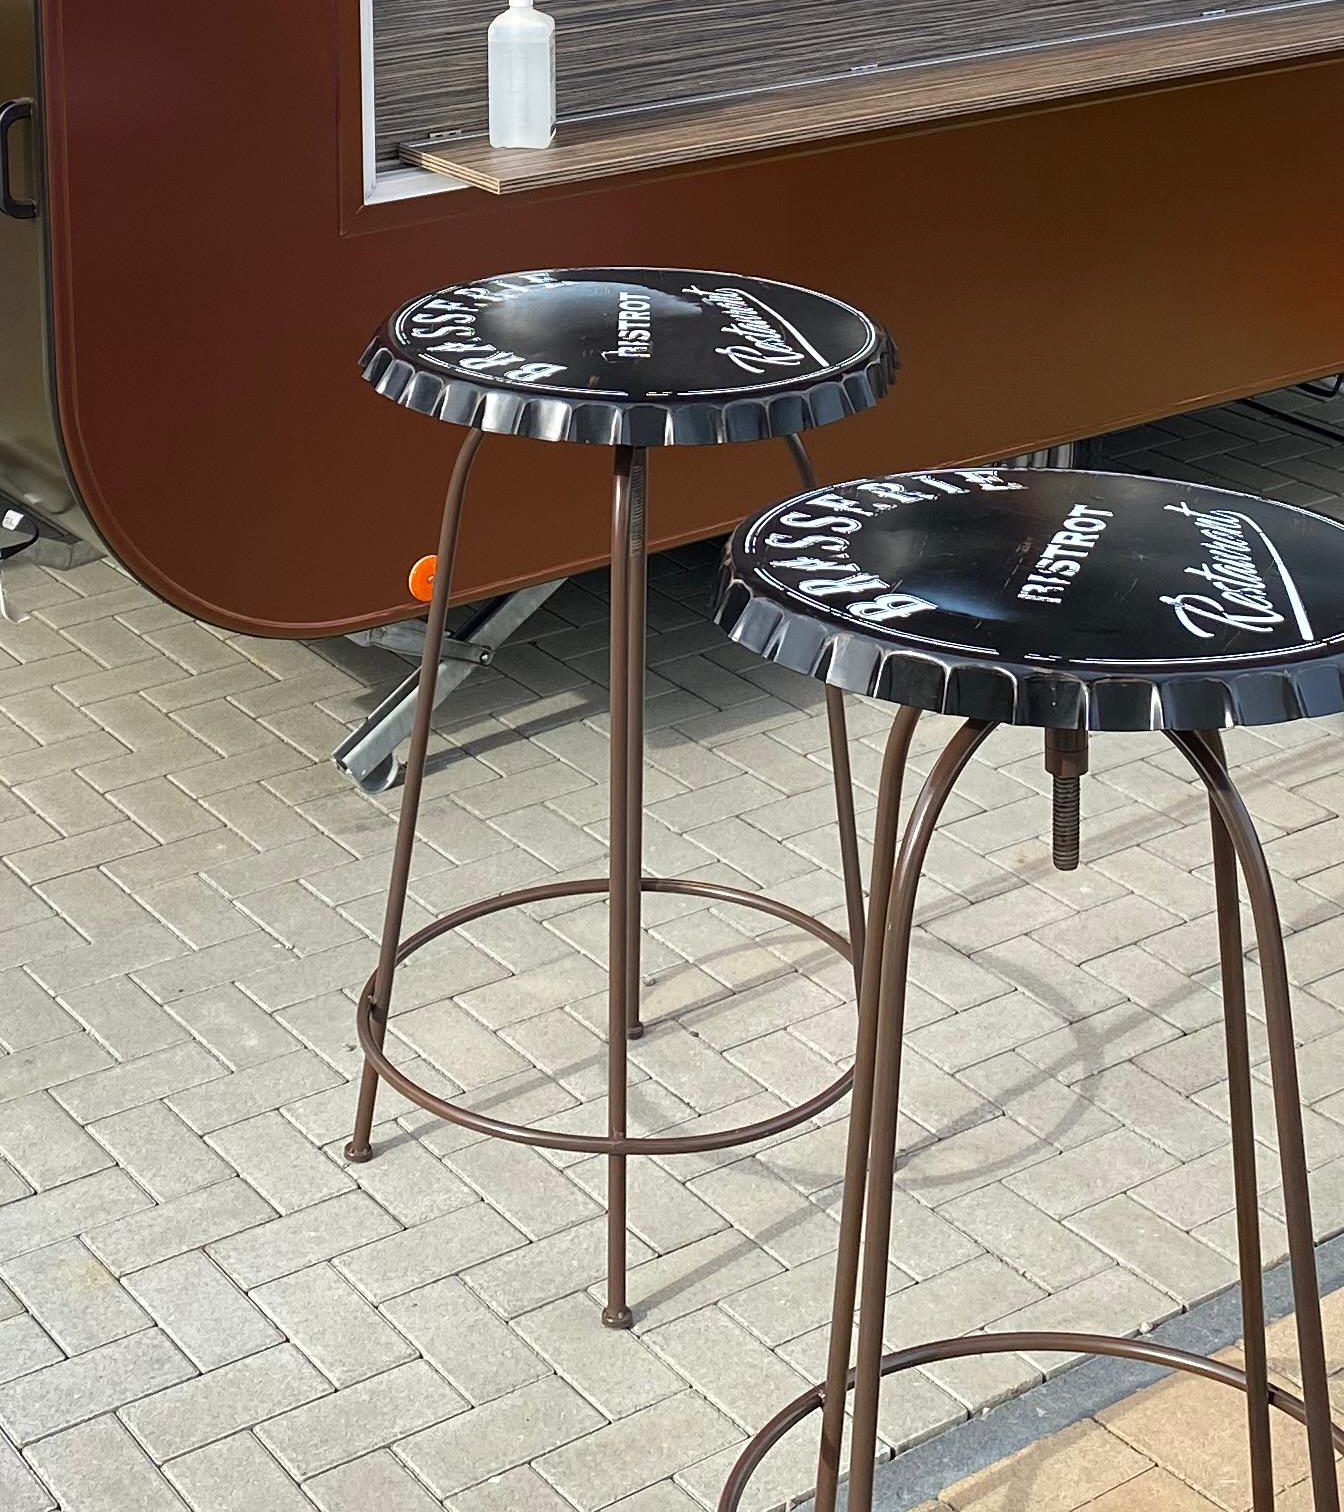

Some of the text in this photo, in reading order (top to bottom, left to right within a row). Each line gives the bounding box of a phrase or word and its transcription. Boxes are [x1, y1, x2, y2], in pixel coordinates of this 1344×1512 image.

[411, 271, 569, 383] BRASSERIE
[681, 284, 809, 374] Restaurant
[764, 470, 1027, 622] BRASSERIE
[1159, 501, 1301, 638] Restaurant
